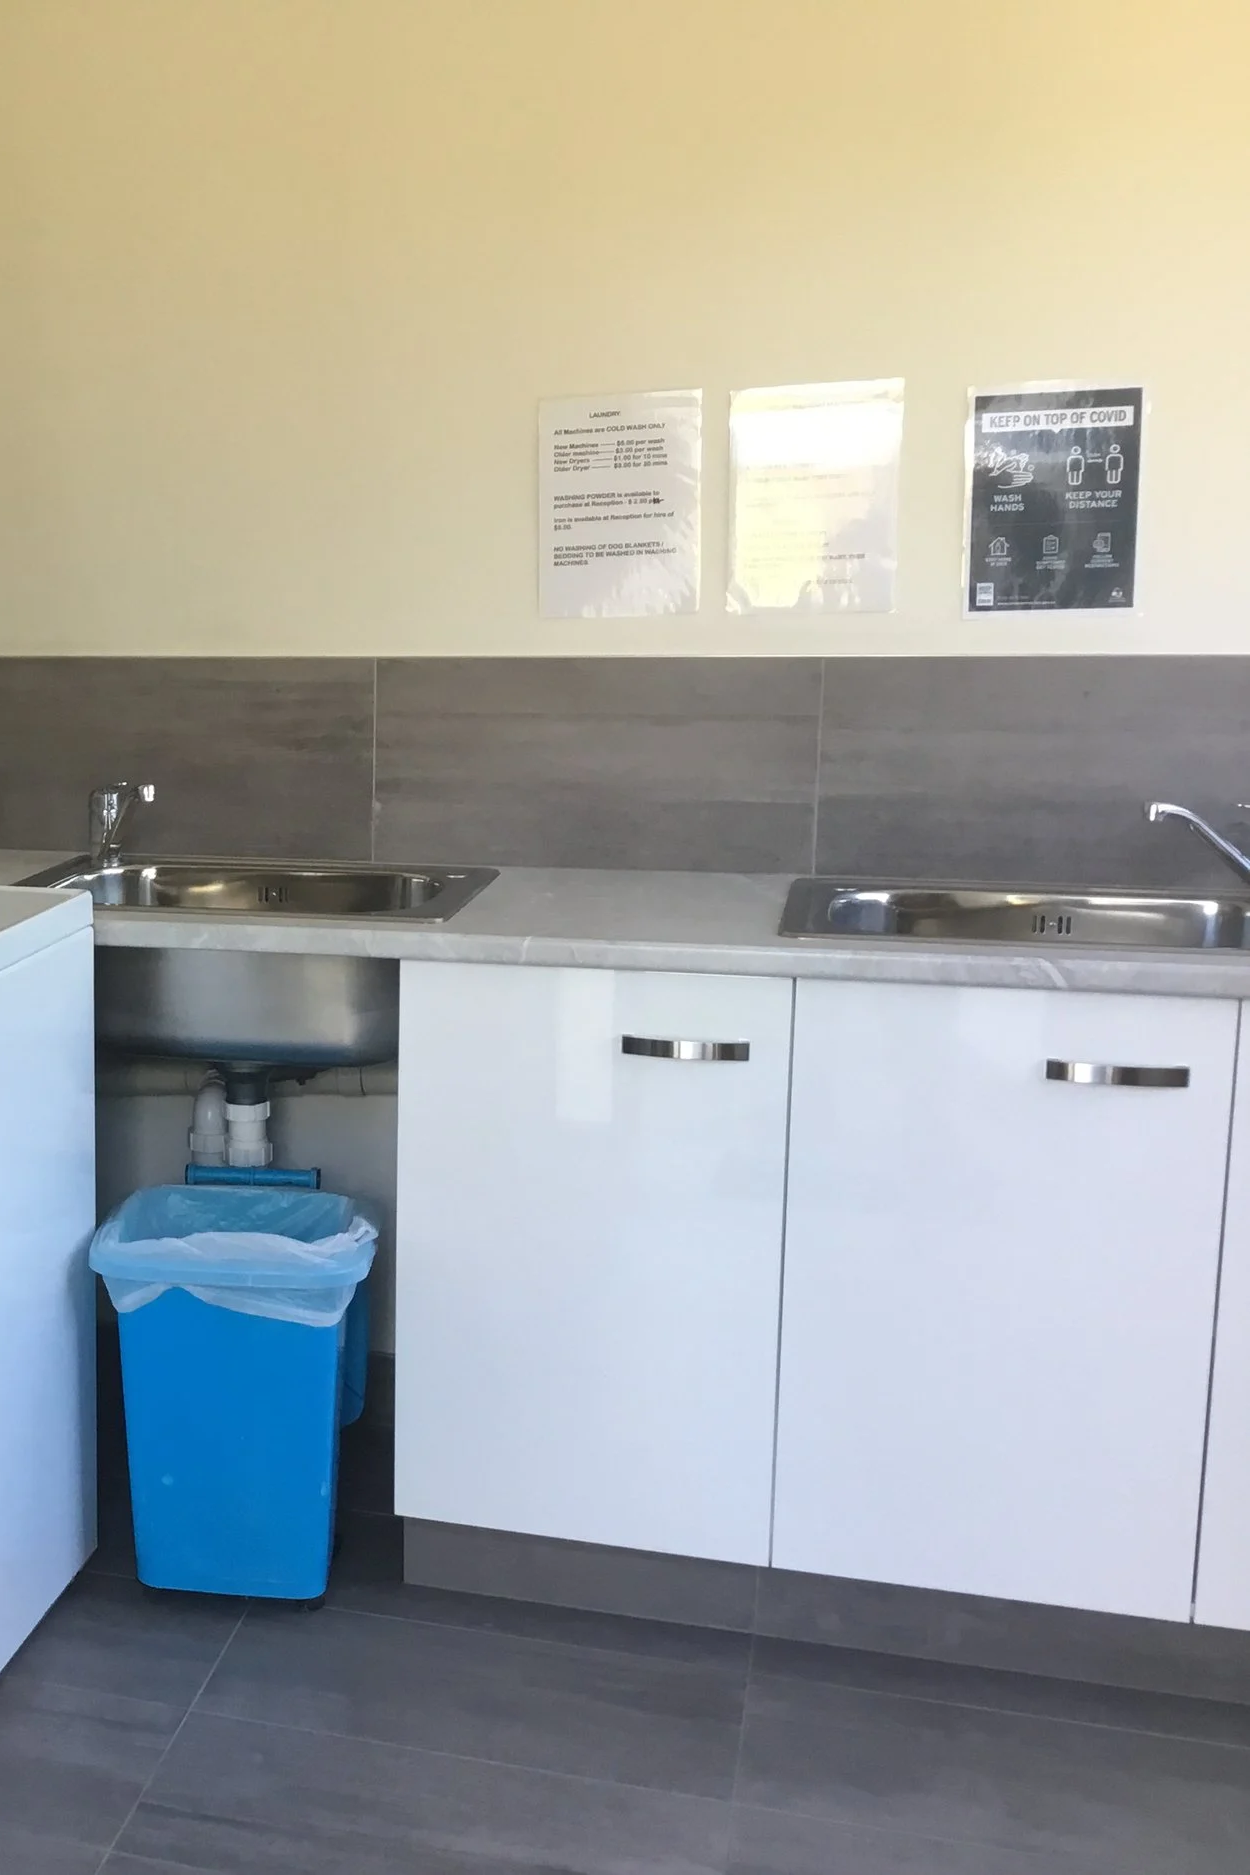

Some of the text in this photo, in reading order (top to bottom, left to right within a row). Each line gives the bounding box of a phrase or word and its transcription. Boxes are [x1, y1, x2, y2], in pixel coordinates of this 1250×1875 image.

[989, 409, 1127, 428] KEEP ON TOP OF COVID
[626, 423, 646, 431] WASH
[587, 492, 615, 500] POWDER
[993, 494, 1022, 503] WASH
[1065, 490, 1122, 500] KEEP YOUR
[990, 503, 1024, 512] HANDS
[1068, 499, 1118, 509] DISTANCE
